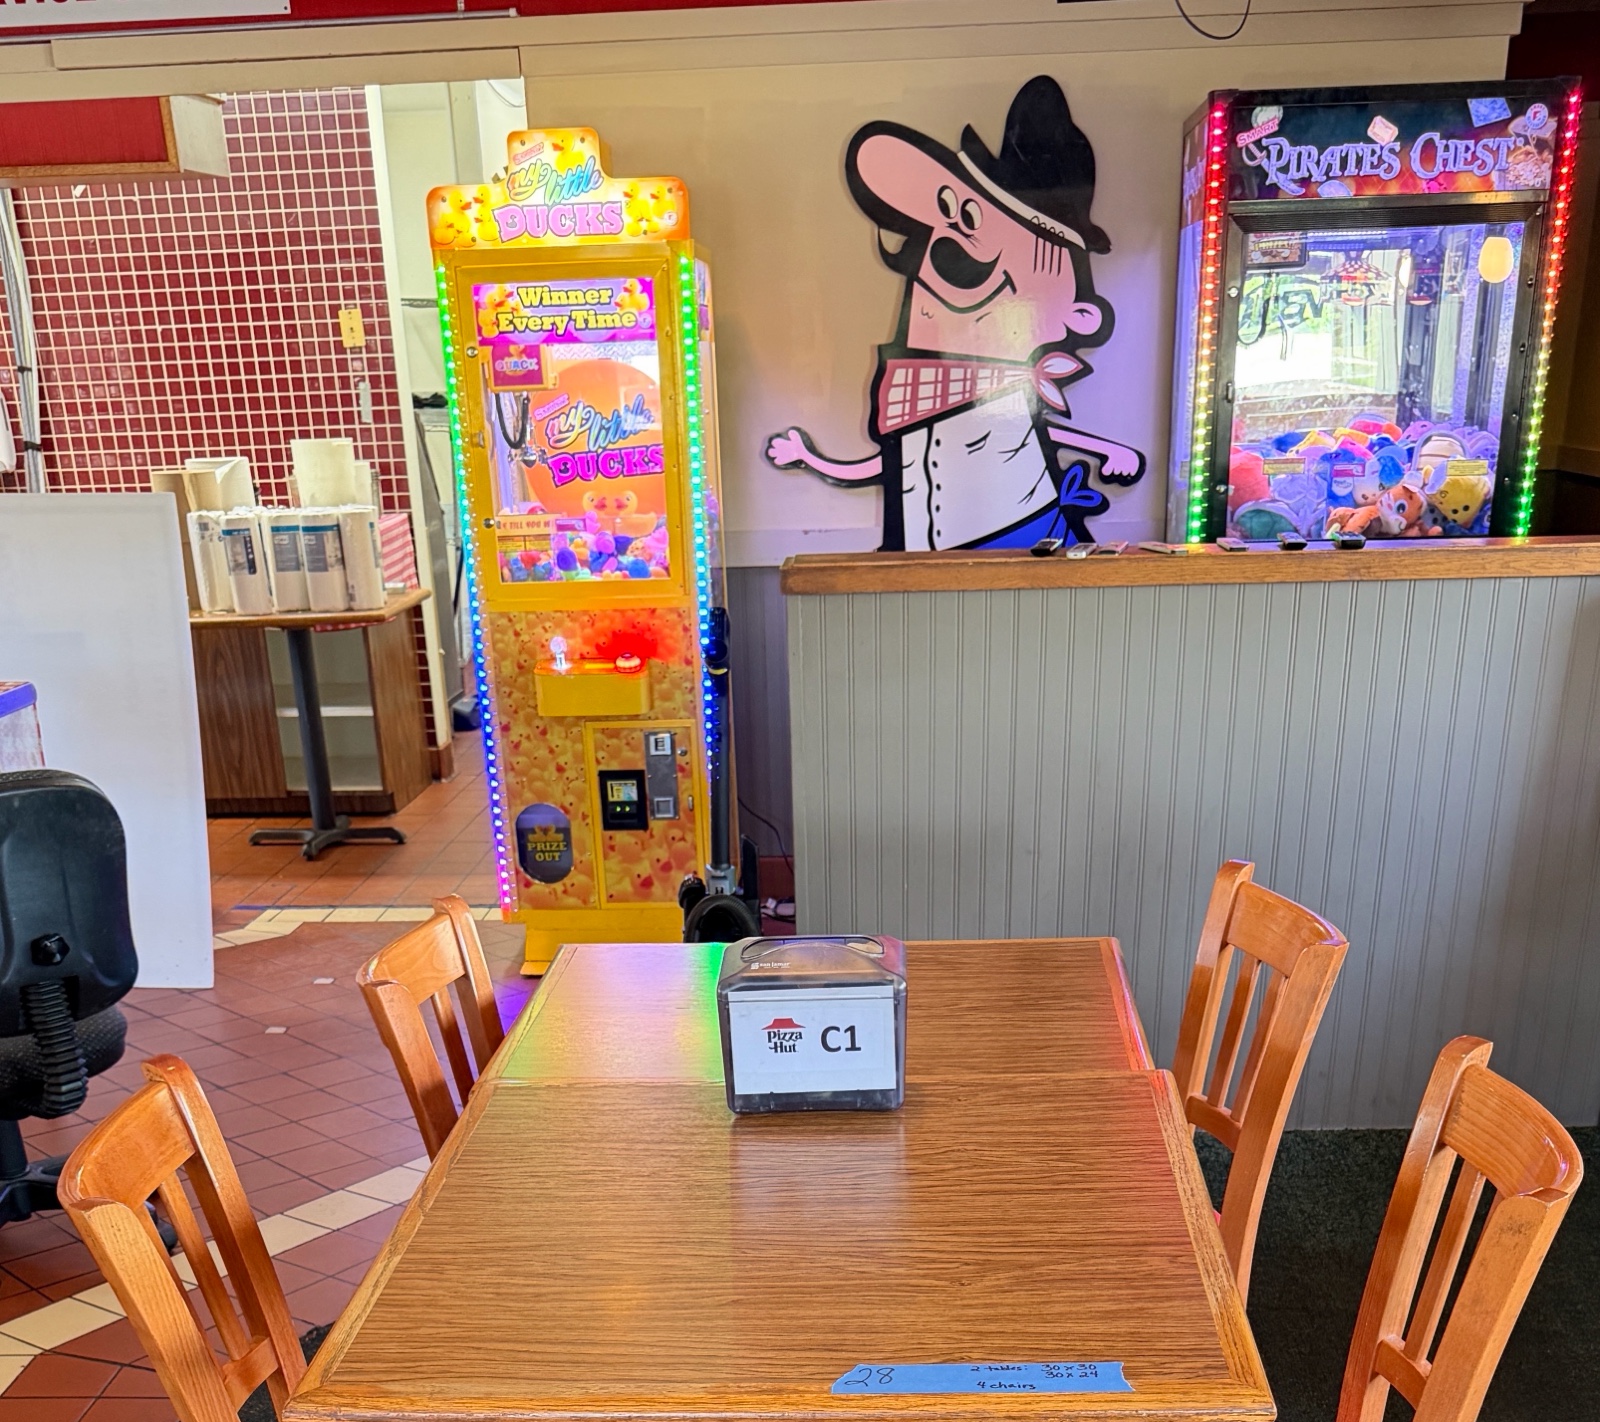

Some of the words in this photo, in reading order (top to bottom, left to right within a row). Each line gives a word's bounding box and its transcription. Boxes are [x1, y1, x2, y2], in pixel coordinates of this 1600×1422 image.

[1238, 119, 1278, 145] SMART
[1262, 133, 1401, 194] PIRATES
[1410, 132, 1515, 178] CHEST
[507, 158, 552, 201] my
[544, 155, 604, 206] little
[492, 201, 624, 243] DUCKS
[517, 286, 613, 308] Winner
[496, 312, 569, 336] Every
[570, 309, 638, 330] Time
[545, 400, 605, 449] my
[547, 443, 664, 488] DUCKS
[527, 842, 567, 851] PRIZE
[535, 852, 561, 862] OUT
[767, 1030, 803, 1043] Pizza
[769, 1041, 797, 1053] Hut
[820, 1025, 862, 1052] C1
[844, 1367, 896, 1387] 28
